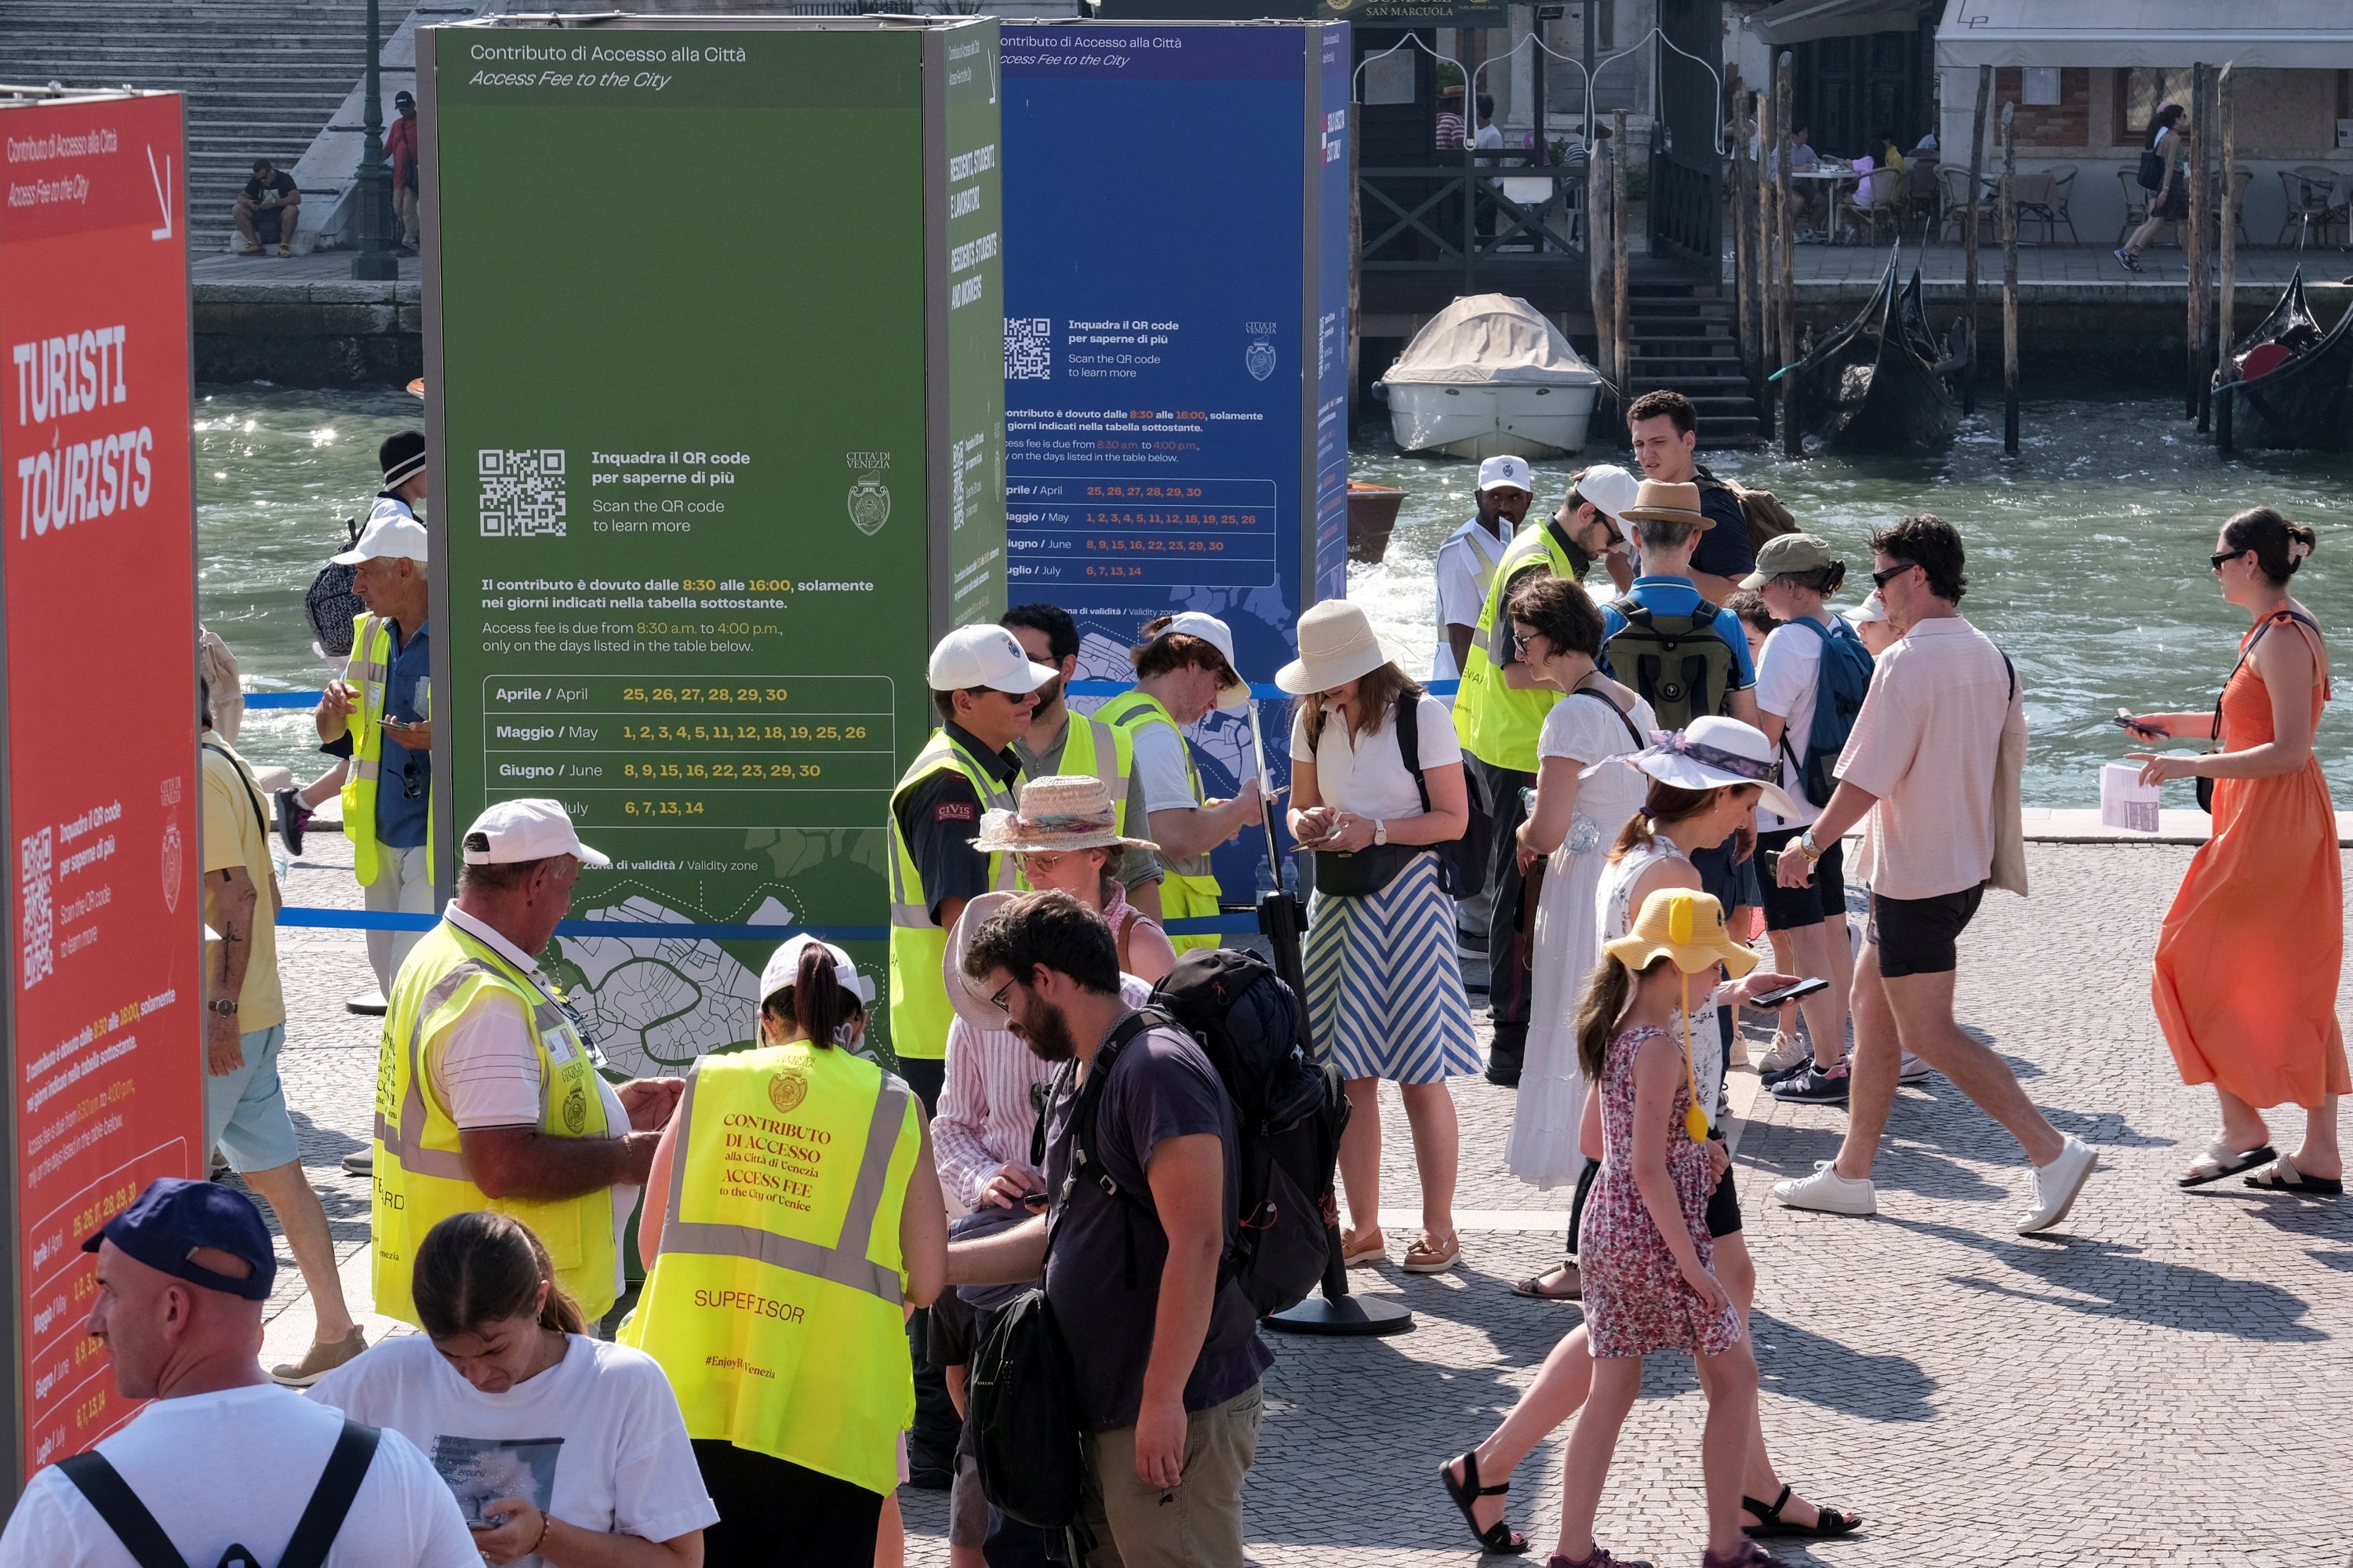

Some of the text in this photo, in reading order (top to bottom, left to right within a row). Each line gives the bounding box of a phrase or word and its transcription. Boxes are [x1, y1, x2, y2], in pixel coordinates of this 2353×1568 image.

[1366, 7, 1453, 16] SAN MARCUOLA
[1001, 35, 1182, 49] ontributo di Accesso alla Città
[471, 44, 746, 62] Contributo di Accesso alla Città
[1000, 53, 1130, 68] ccess Fee to the City
[468, 70, 672, 91] Access Fee to the City
[7, 128, 118, 163] Contributo di Accesso alla Città
[950, 144, 995, 183] RESIDENTI, STUDENTI
[8, 173, 89, 207] Access Fee to the City
[951, 185, 980, 220] E LAVORATORI
[951, 231, 998, 274] RESIDENTS, STUDENTS
[951, 273, 982, 311] AND WORKERS
[1068, 319, 1180, 332] Inquadra il QR code
[1068, 334, 1168, 346] per saperne di più
[13, 324, 126, 426] TURISTI
[591, 451, 751, 467] Inquadra il QR code
[846, 452, 878, 460] CITTA'
[846, 460, 890, 469] VENEZIA
[17, 426, 153, 540] TOURISTS
[591, 471, 735, 487] per saperne di più
[592, 499, 725, 513] Scan the QR code
[592, 518, 691, 532] to learn more
[482, 578, 875, 594] Il contributo è dovuto dalle 8:30 alle 16:00, solamente
[482, 596, 787, 611] nei giorni indicati nella tabella sottostante.
[482, 621, 783, 637] Access fee is due from 8:30 a.m. to 4:00 p.m.,
[495, 687, 787, 704] Aprile / April 25, 26, 27, 28, 29, 30
[939, 804, 969, 814] CIVIS
[60, 799, 122, 844] Inquadra il QR code
[60, 834, 115, 882] per saperne di più
[562, 1068, 584, 1082] VENEZIA
[723, 1113, 831, 1145] CONTRIBUTO
[726, 1133, 821, 1164] DI ACCESSO
[725, 1151, 819, 1178] alla Città di Venezia
[722, 1168, 813, 1199] ACCESS FEE
[719, 1186, 811, 1212] to the City of Venice
[37, 1389, 106, 1465] Luglio / July 6, 7, 13, 14
